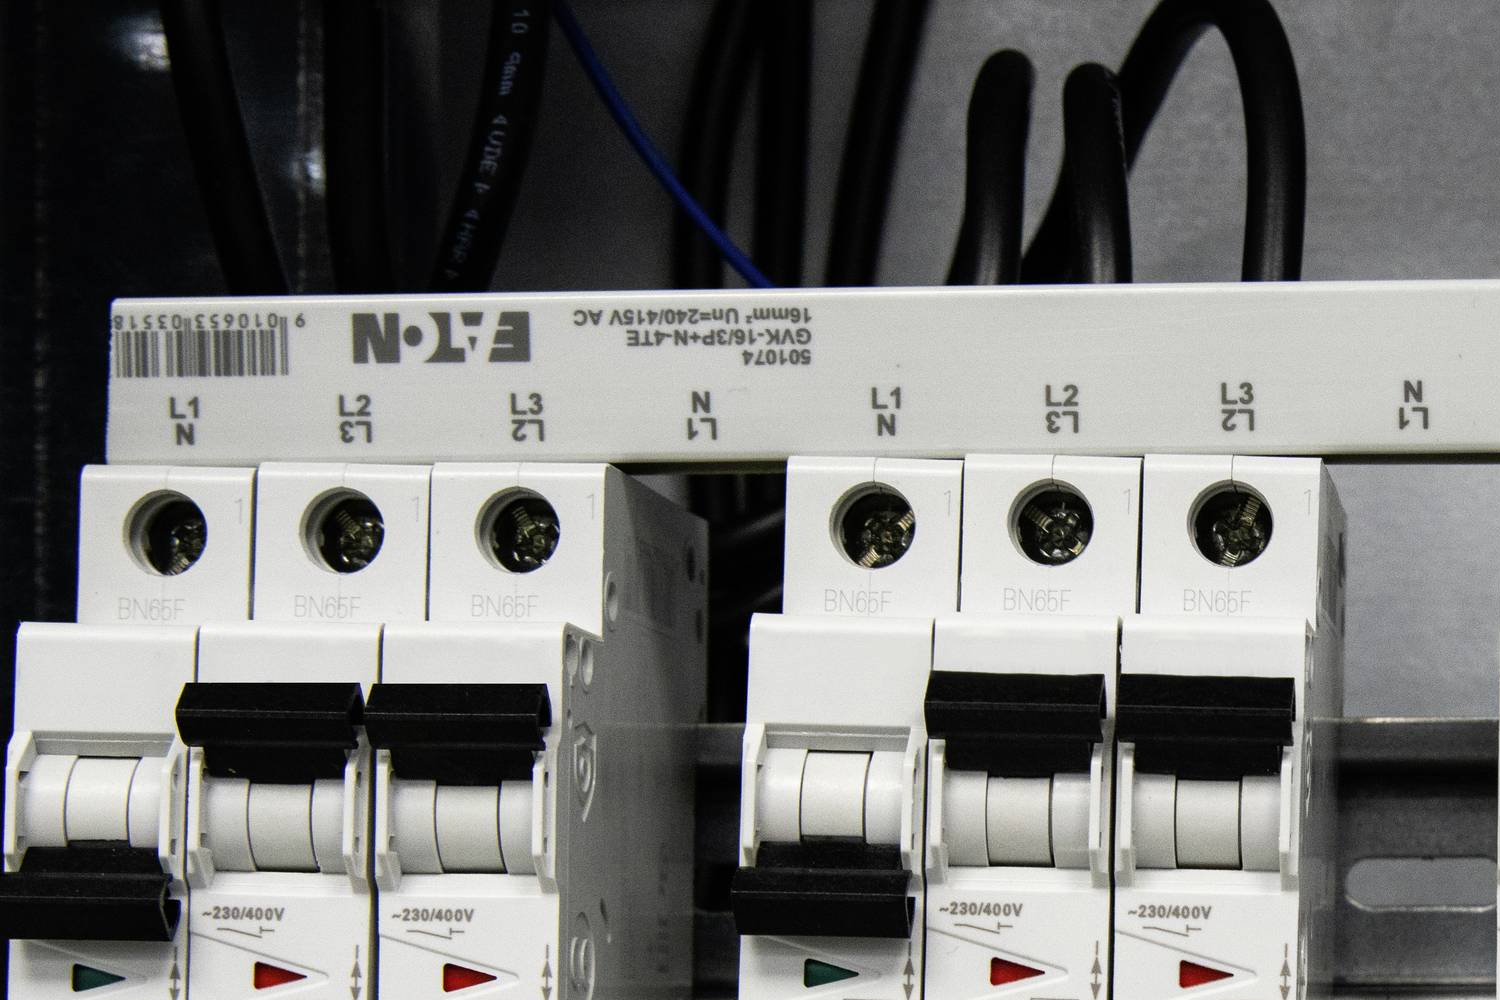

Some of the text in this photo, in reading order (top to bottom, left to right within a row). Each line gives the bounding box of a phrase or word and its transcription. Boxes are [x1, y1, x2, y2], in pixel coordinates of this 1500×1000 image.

[573, 308, 602, 326] AC
[609, 308, 740, 326] Un=240/415V
[352, 311, 532, 364] EATON
[626, 328, 812, 347] GVK-16/3P+N-4TE
[742, 349, 811, 366] 501074
[692, 391, 711, 414] N
[871, 387, 901, 410] L1
[1045, 384, 1079, 408] L2
[1221, 381, 1254, 405] L3
[1405, 380, 1423, 403] N
[169, 396, 200, 420] L1
[338, 394, 371, 417] L2
[511, 392, 543, 416] L3
[688, 417, 718, 441] L1
[877, 413, 896, 436] N
[1046, 411, 1080, 434] L3
[1222, 409, 1255, 432] L2
[1400, 407, 1429, 430] L1
[176, 424, 196, 447] N
[340, 421, 373, 445] L3
[512, 419, 545, 443] L2
